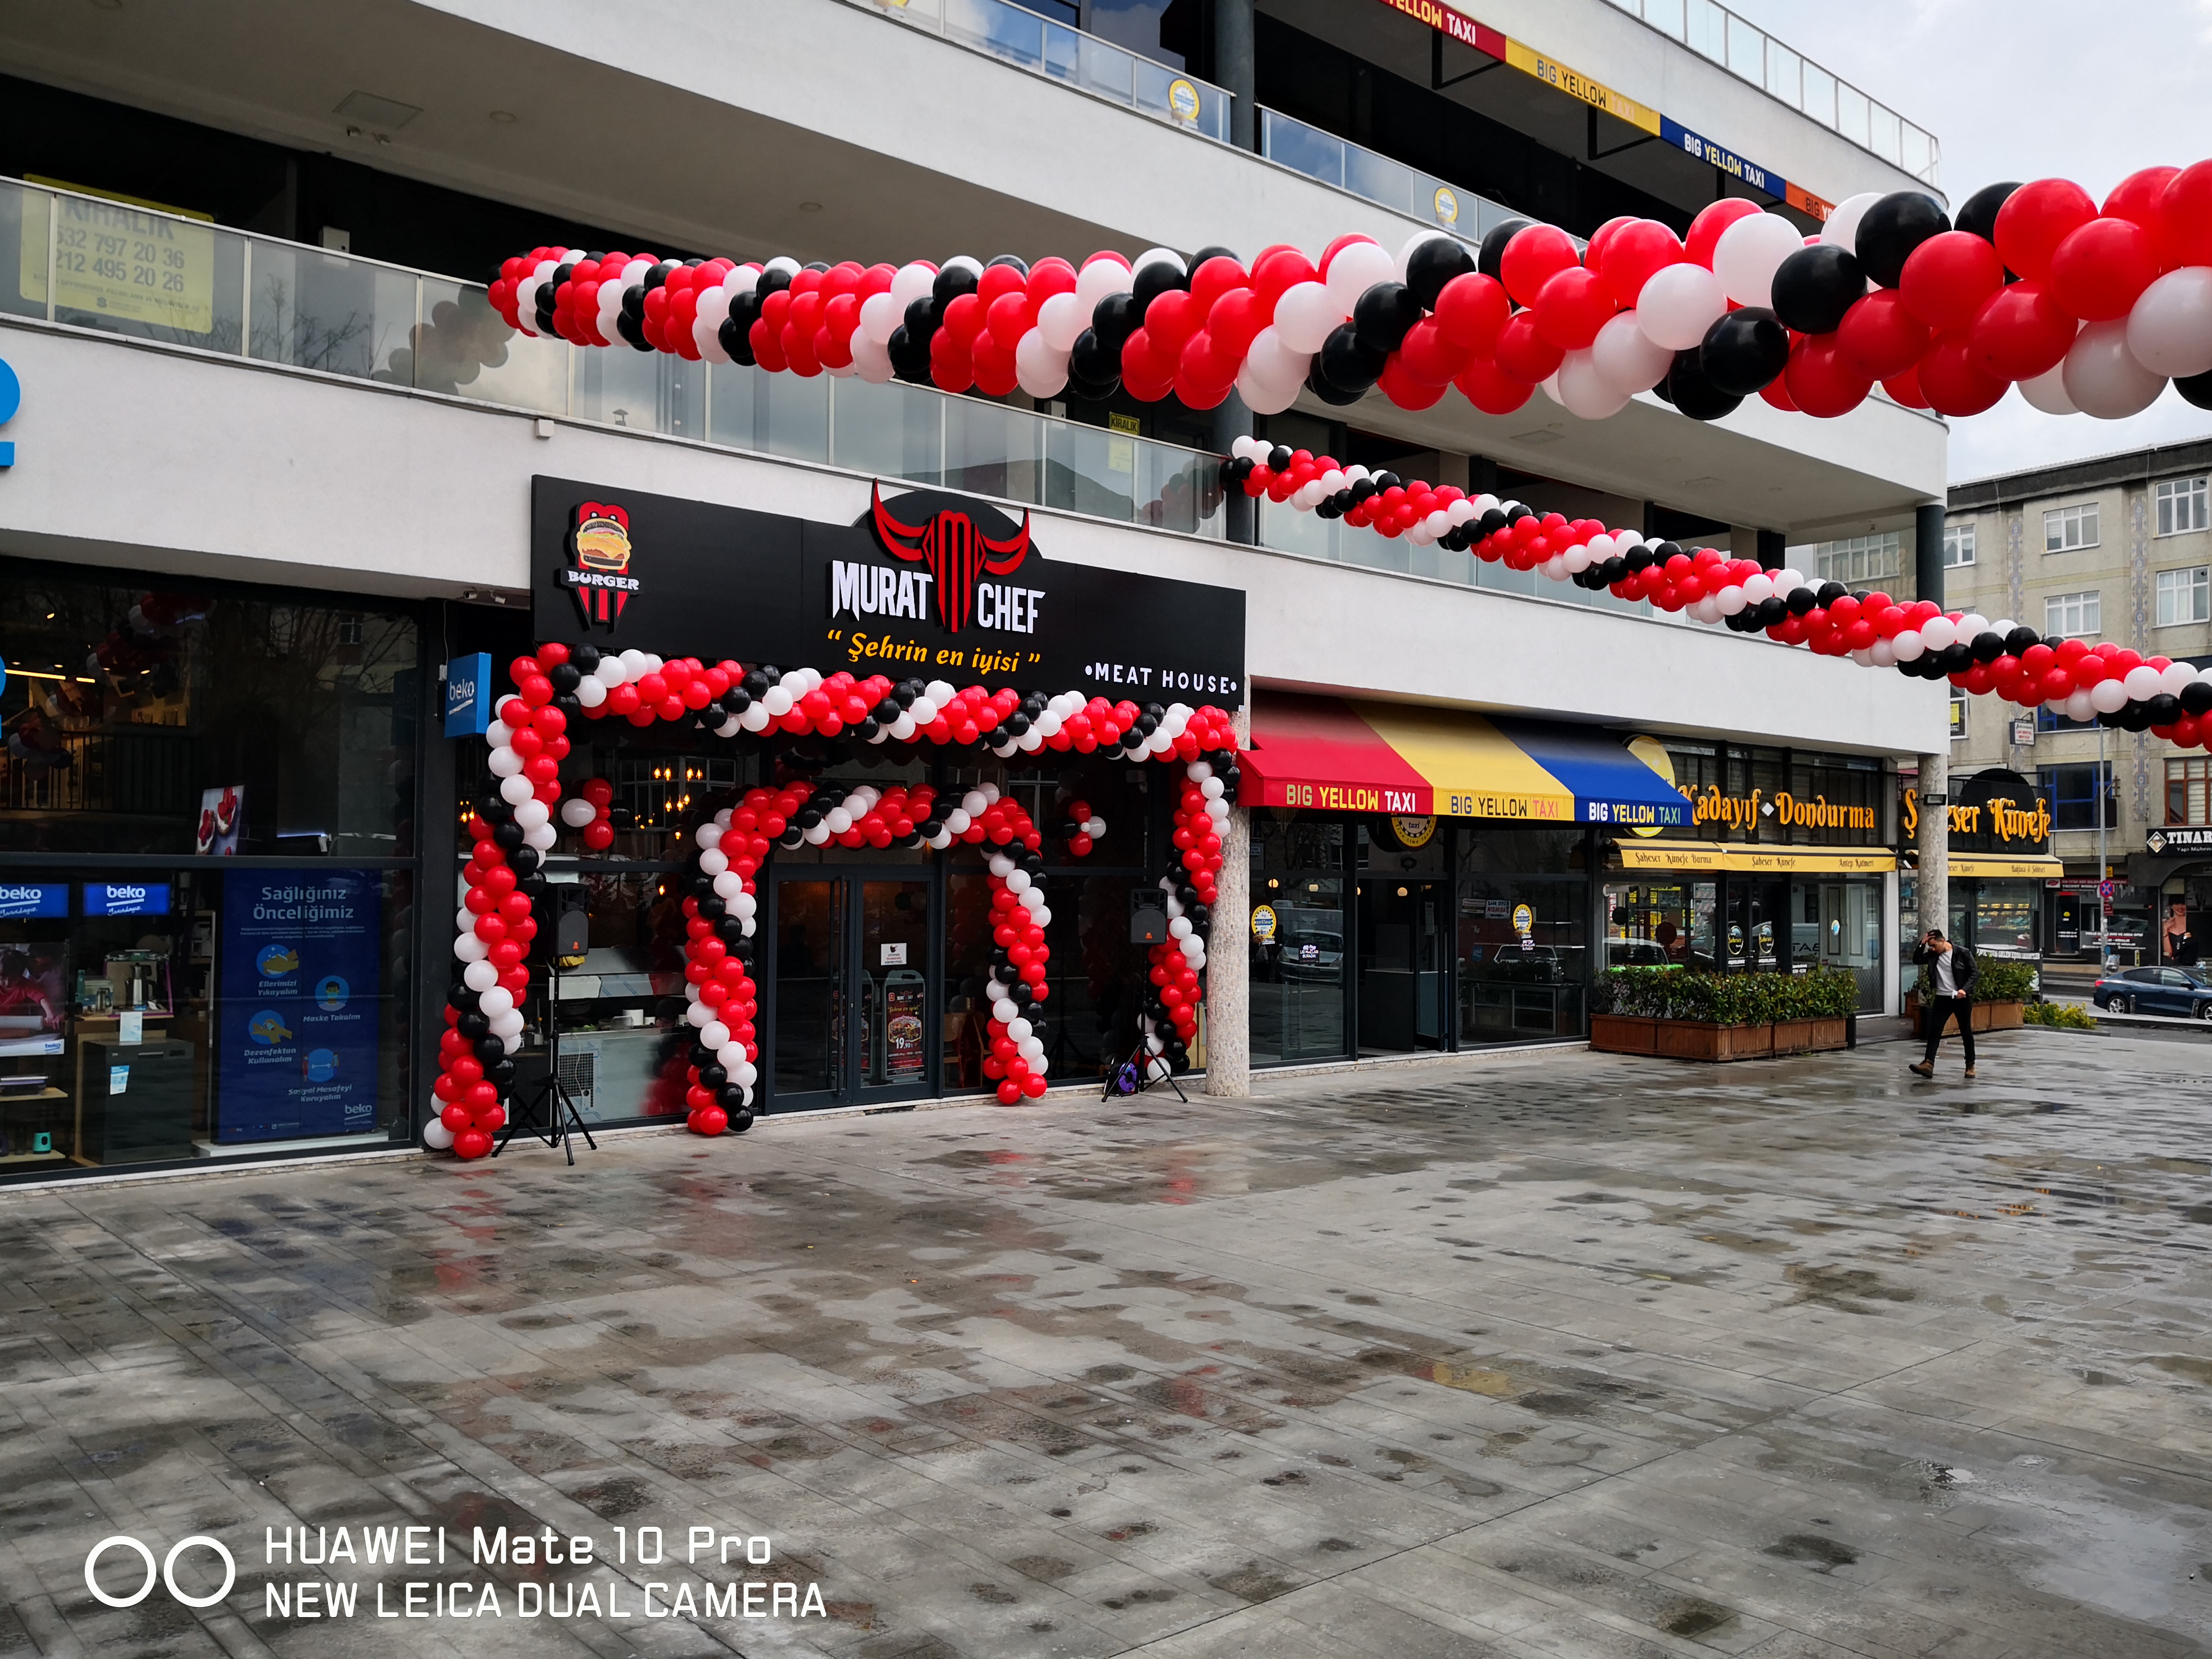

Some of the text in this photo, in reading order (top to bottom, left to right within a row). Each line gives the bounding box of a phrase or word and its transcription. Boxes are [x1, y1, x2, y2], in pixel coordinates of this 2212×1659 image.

[1446, 13, 1475, 45] TAXI
[1537, 59, 1635, 121] BIG YELLOW TAXI
[1684, 133, 1765, 189] BIG YELLOW TAXI
[1806, 197, 1820, 217] BIG
[94, 232, 127, 257] 797
[134, 241, 156, 263] 20
[163, 248, 184, 269] 36
[92, 257, 126, 281] 495
[134, 265, 156, 286] 20
[163, 271, 184, 292] 26
[567, 570, 639, 591] BURGER
[832, 559, 1046, 634] MURAT CHEF
[936, 650, 964, 667] en
[449, 678, 475, 701] beko
[1286, 784, 1416, 813] BIG YELLOW TAXI
[1451, 795, 1559, 818] BIG YELLOW TAXI
[1589, 802, 1681, 824] BIG YELLOW TAXI
[1775, 792, 1875, 830] Dondurma
[1987, 798, 2051, 843] Künefe
[1635, 852, 1712, 865] Şaheser Künefe Burma
[1752, 857, 1796, 868] Şaheser Künefe
[0, 886, 42, 899] beko
[107, 885, 146, 898] beko
[261, 886, 347, 903] Sağlığınız
[253, 903, 354, 922] Önceliğimiz
[244, 1047, 297, 1057] Dezenfektan
[248, 1056, 292, 1065] Kullanalım
[344, 1103, 373, 1114] beko
